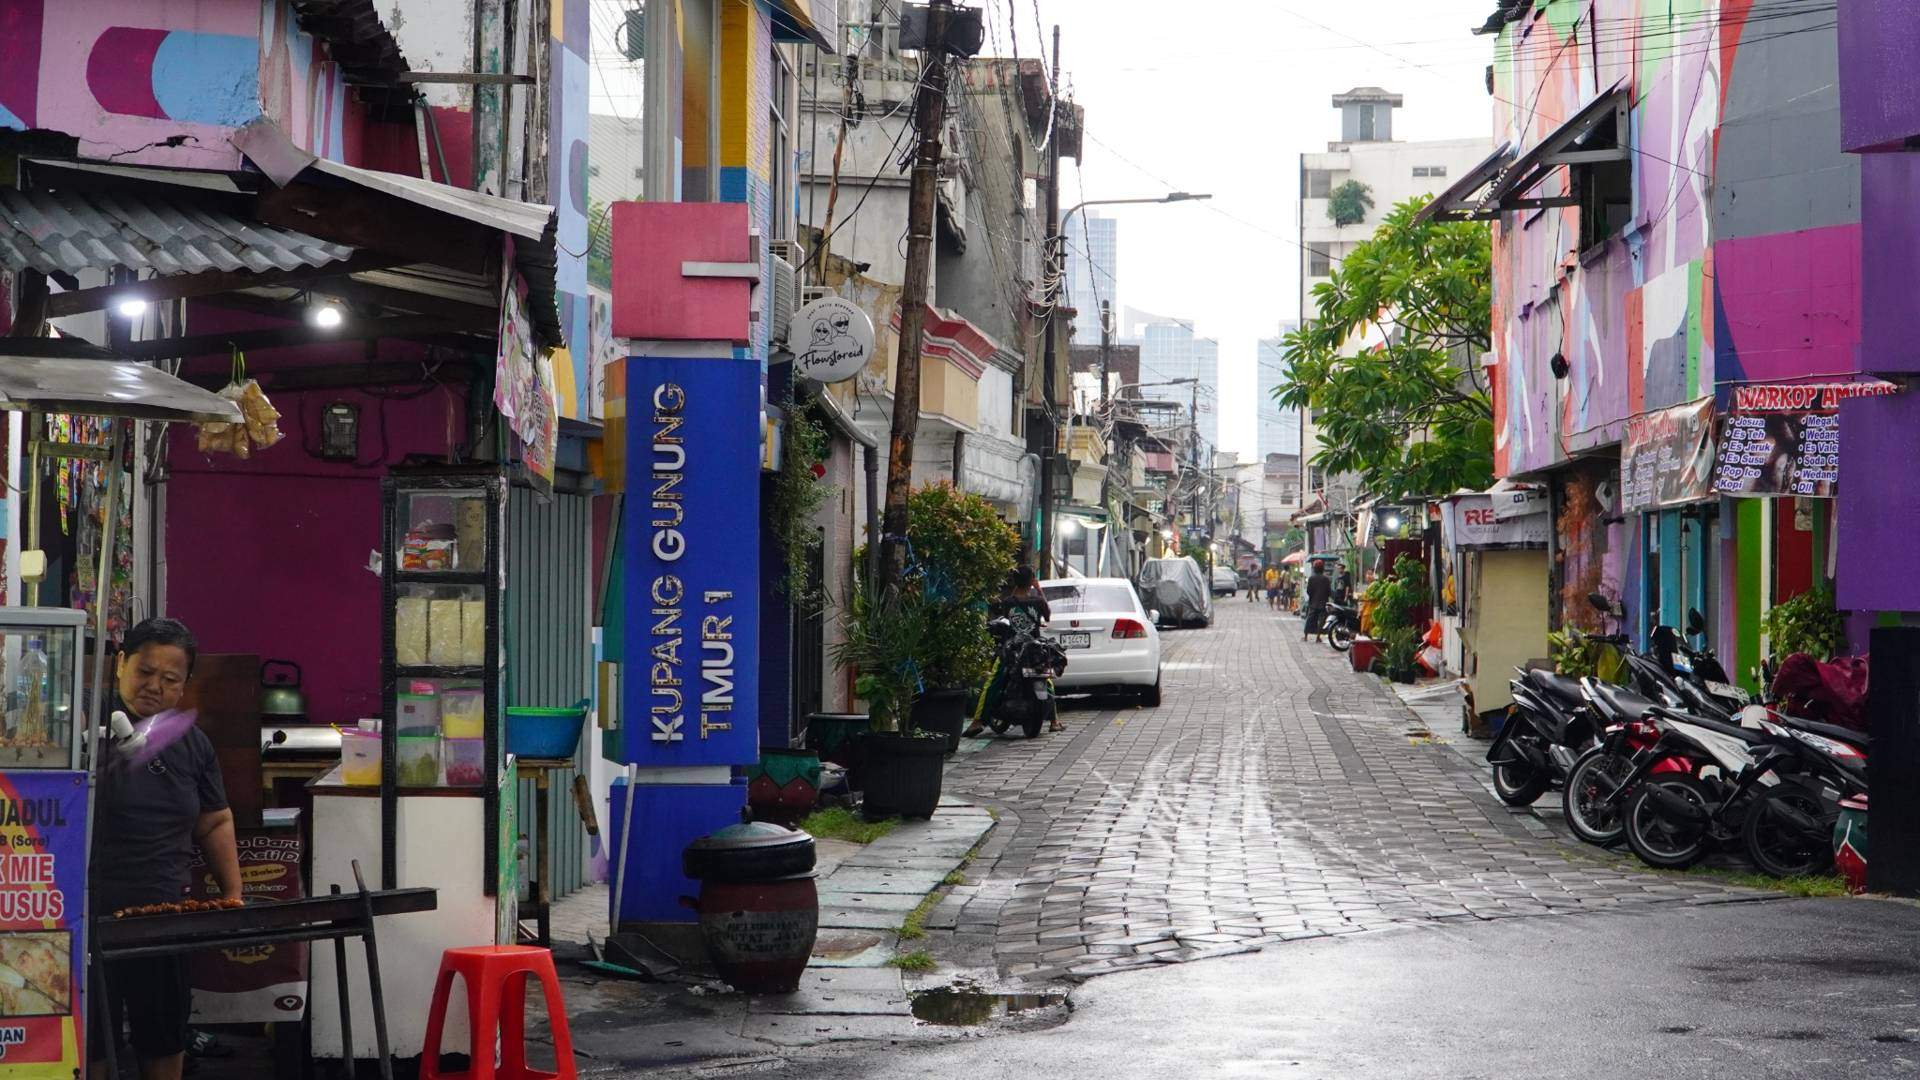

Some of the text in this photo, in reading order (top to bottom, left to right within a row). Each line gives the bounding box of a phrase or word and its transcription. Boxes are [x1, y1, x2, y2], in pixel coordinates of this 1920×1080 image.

[1735, 385, 1818, 410] WARKOP
[1735, 416, 1766, 428] Josua
[1807, 415, 1832, 428] Mega
[1731, 429, 1766, 441] Es Teh
[1729, 441, 1773, 453] Es Jeruk
[1804, 442, 1817, 453] Es
[1725, 453, 1766, 465] Es Susu
[1803, 455, 1826, 466] Soda
[1721, 464, 1743, 478] Pop
[1801, 468, 1838, 482] Wedang
[1719, 479, 1744, 491] Kopi
[652, 383, 686, 743] KUPANG GUNUNG
[700, 615, 735, 741] TIMUR
[11, 834, 50, 850] (Sore)
[9, 854, 55, 885] MIE
[0, 886, 65, 921] USUS
[0, 1027, 26, 1044] AN
